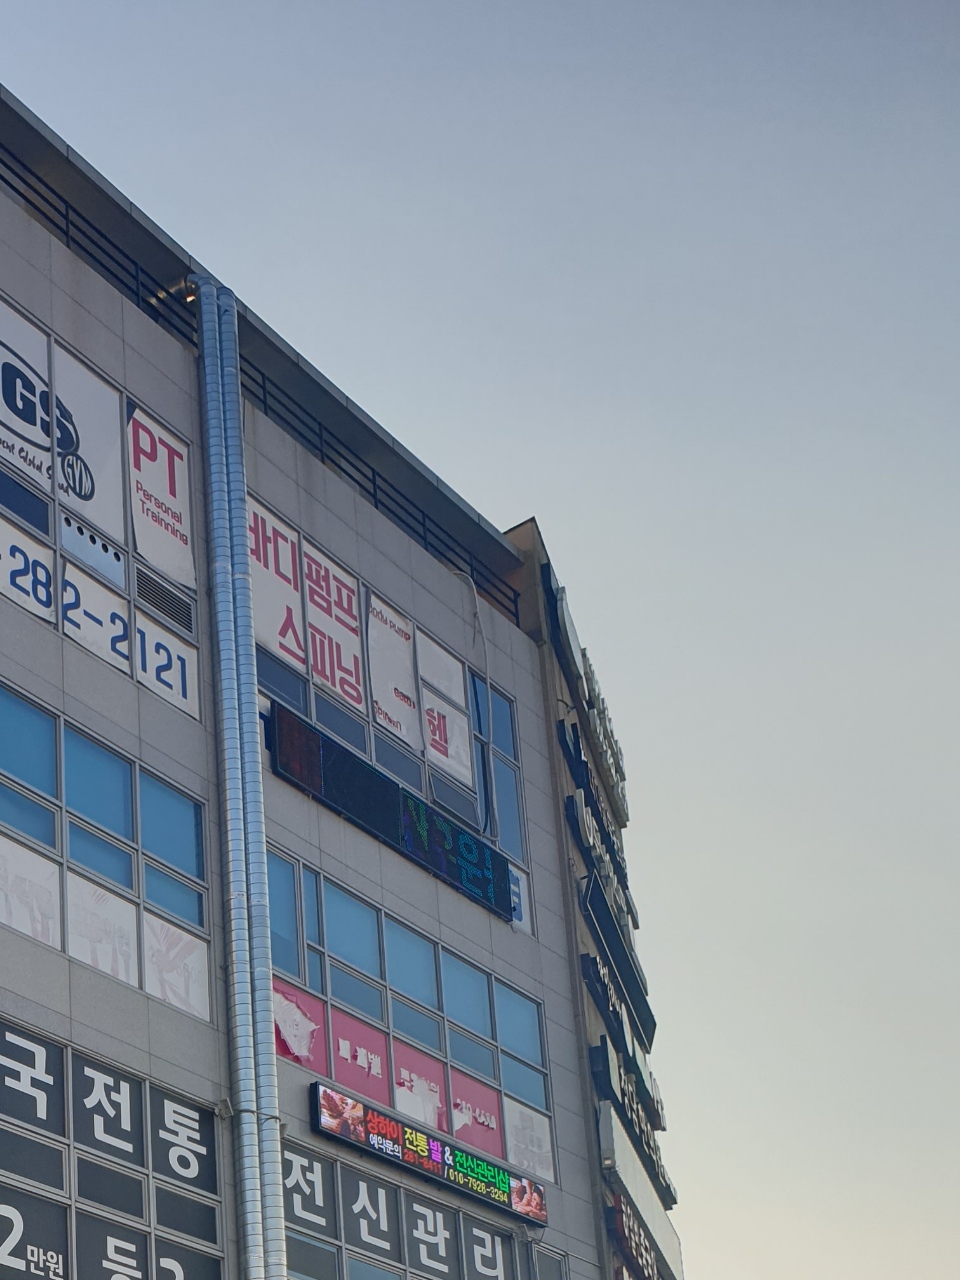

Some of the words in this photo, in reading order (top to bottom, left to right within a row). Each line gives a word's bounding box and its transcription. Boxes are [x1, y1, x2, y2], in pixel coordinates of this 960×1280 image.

[63, 453, 93, 498] GYM
[132, 416, 184, 499] PT
[136, 479, 183, 526] Personal
[279, 605, 363, 706] 스피닝
[366, 1109, 403, 1145] 상하이
[404, 1127, 430, 1157] 전통
[429, 1138, 443, 1163] 발
[444, 1146, 454, 1166] &
[454, 1150, 510, 1194] 전신관리샵
[369, 1133, 402, 1160] 예약문의
[403, 1148, 443, 1176] 281-8411
[449, 1168, 509, 1204] 010-7928-3294
